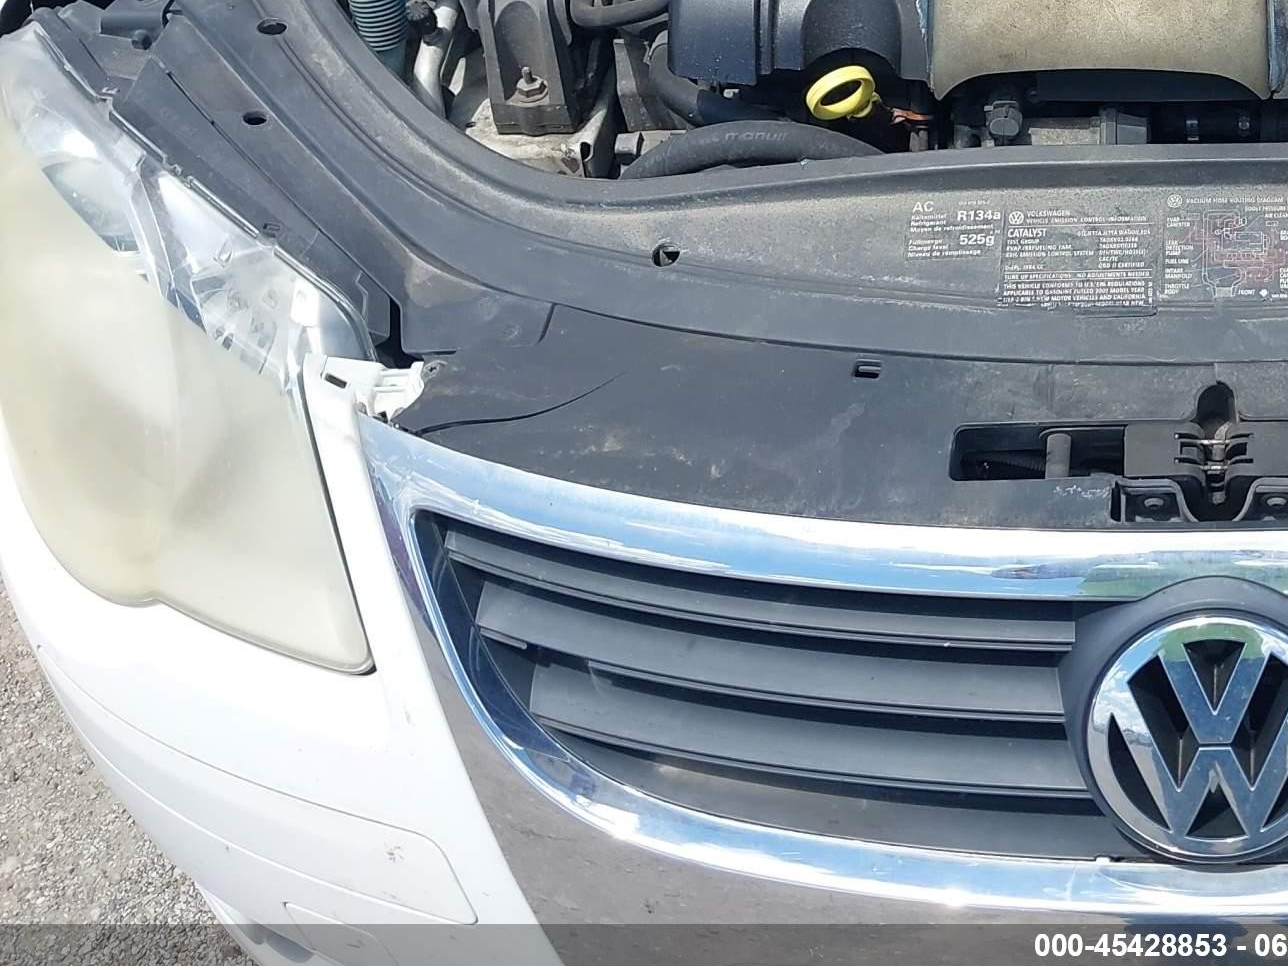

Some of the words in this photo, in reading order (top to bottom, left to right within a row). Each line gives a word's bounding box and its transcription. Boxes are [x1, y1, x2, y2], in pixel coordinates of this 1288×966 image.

[912, 201, 934, 213] AC
[957, 209, 1001, 221] R134a
[1008, 228, 1047, 237] CATALYST
[960, 234, 995, 246] 525g
